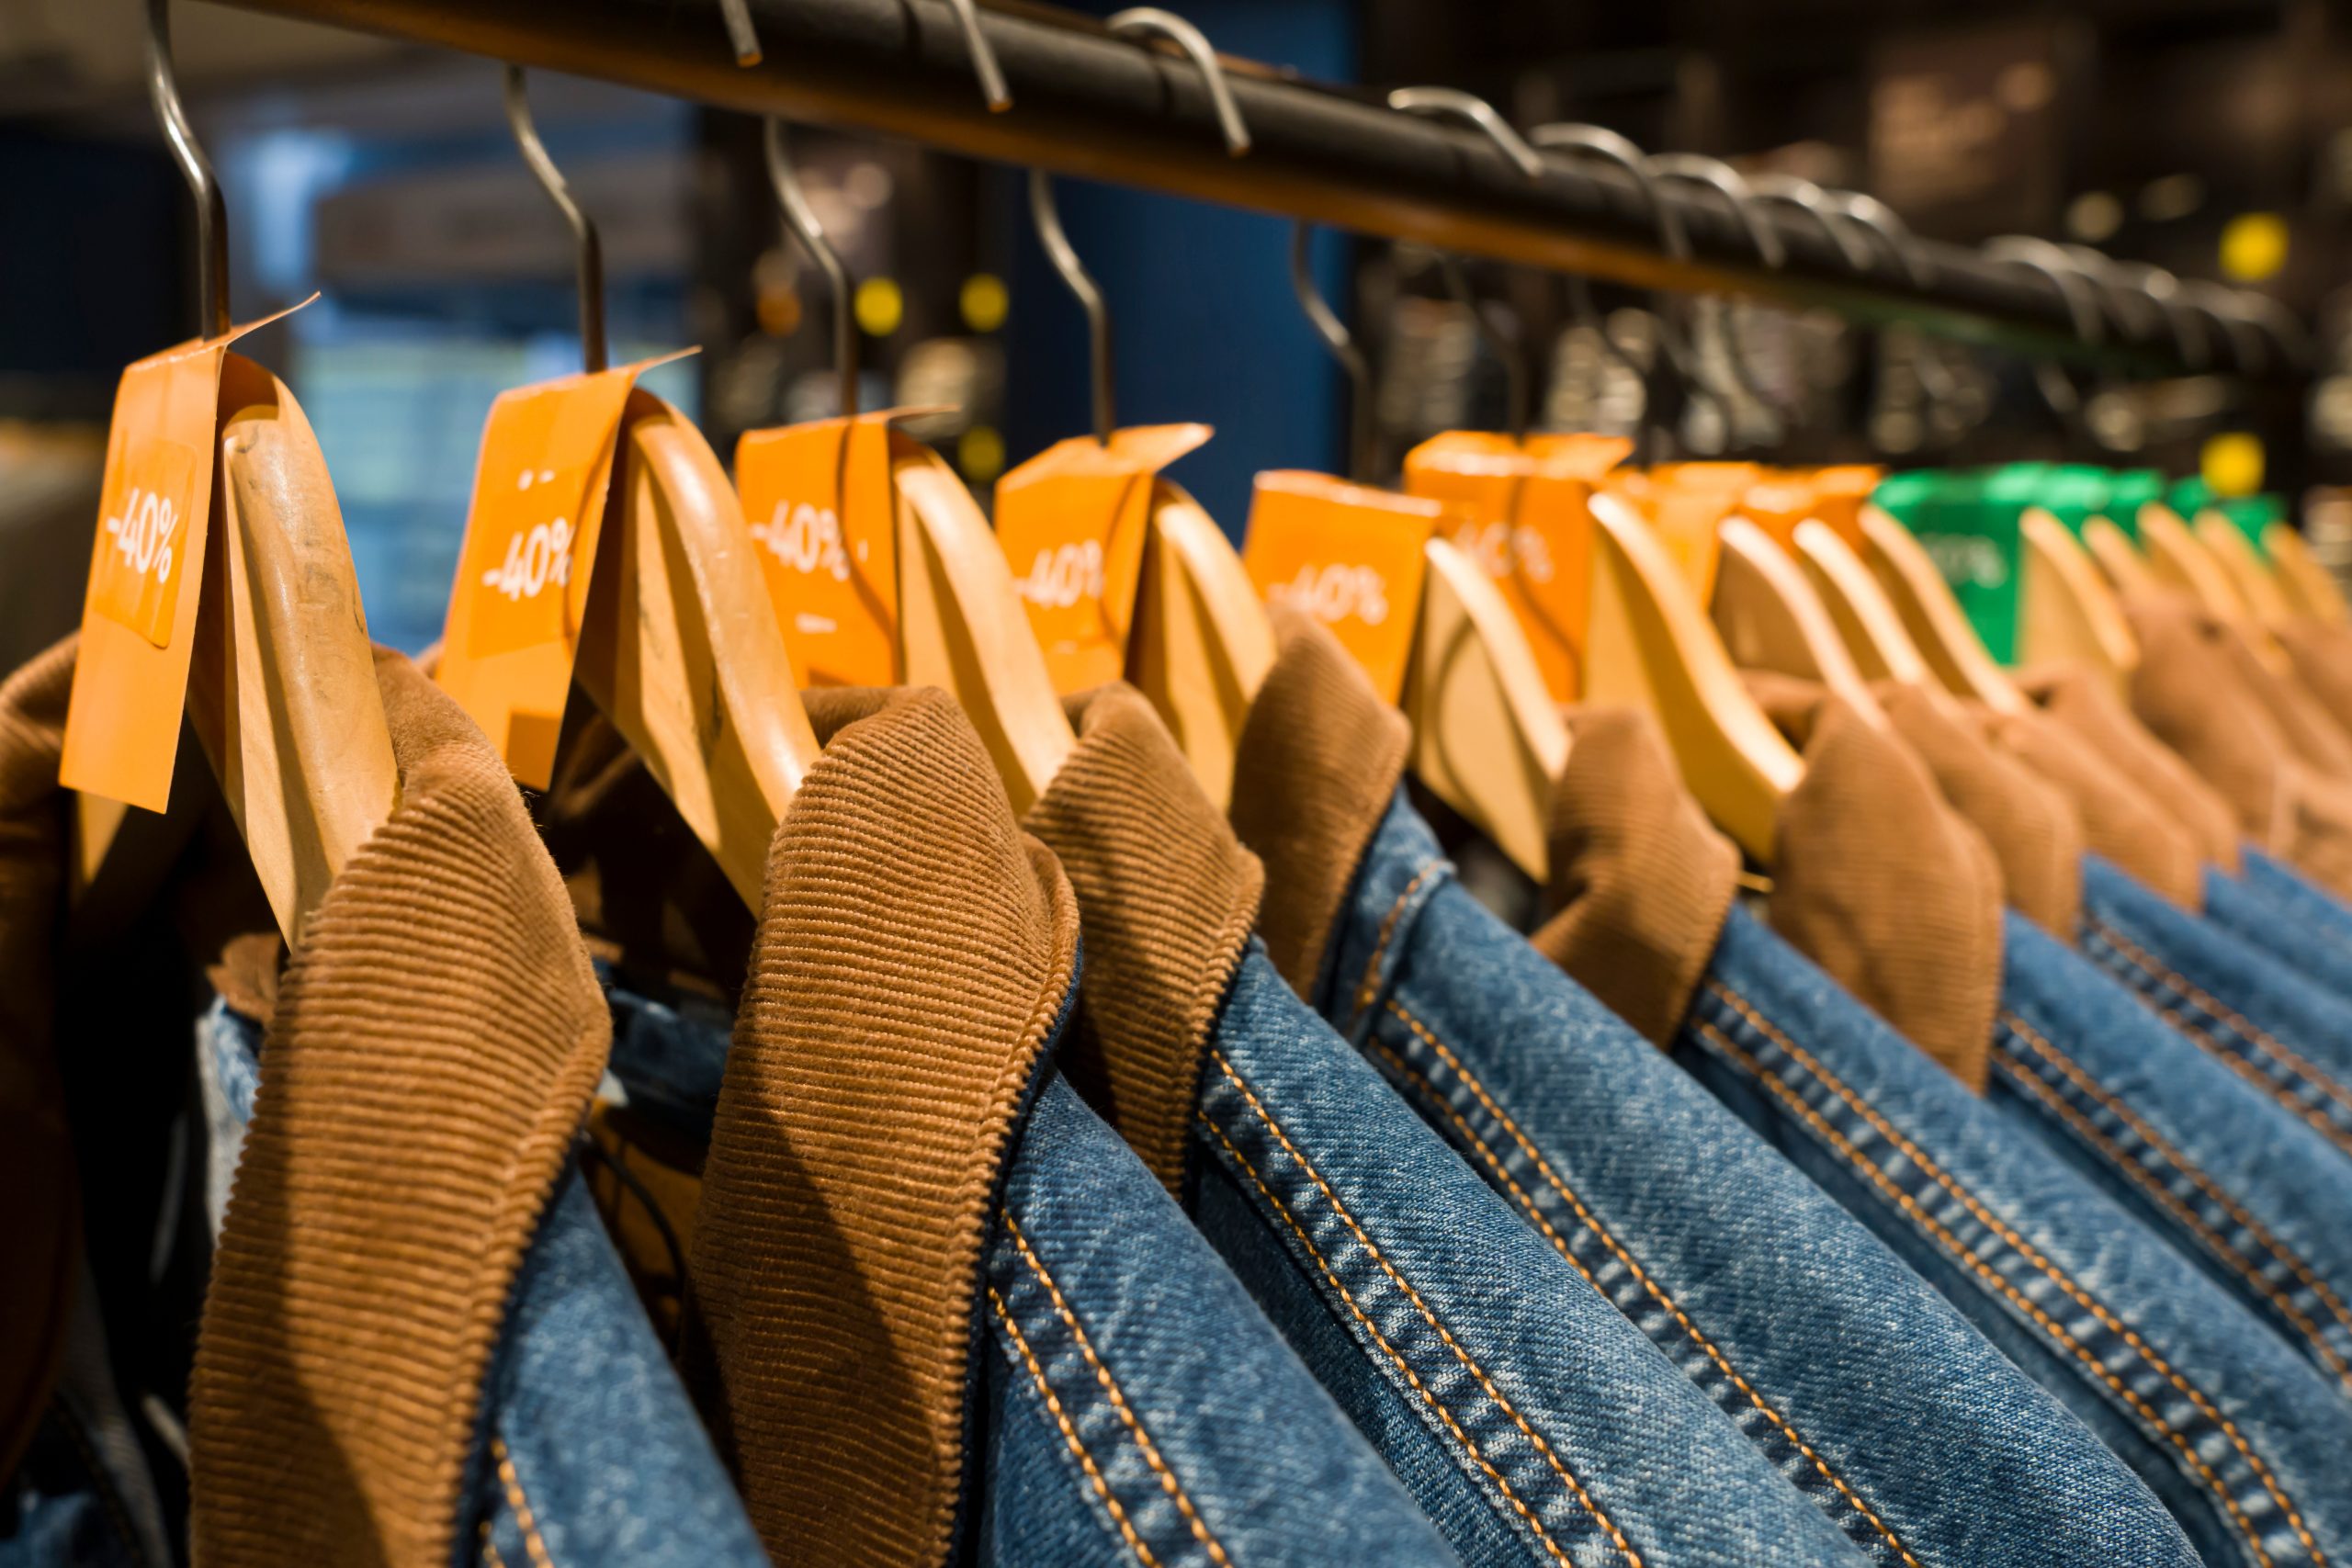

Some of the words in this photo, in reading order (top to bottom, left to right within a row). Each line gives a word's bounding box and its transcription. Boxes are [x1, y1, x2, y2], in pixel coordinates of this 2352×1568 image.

[107, 487, 178, 583] -40%
[481, 516, 574, 602] -40%
[750, 500, 851, 581] -40%
